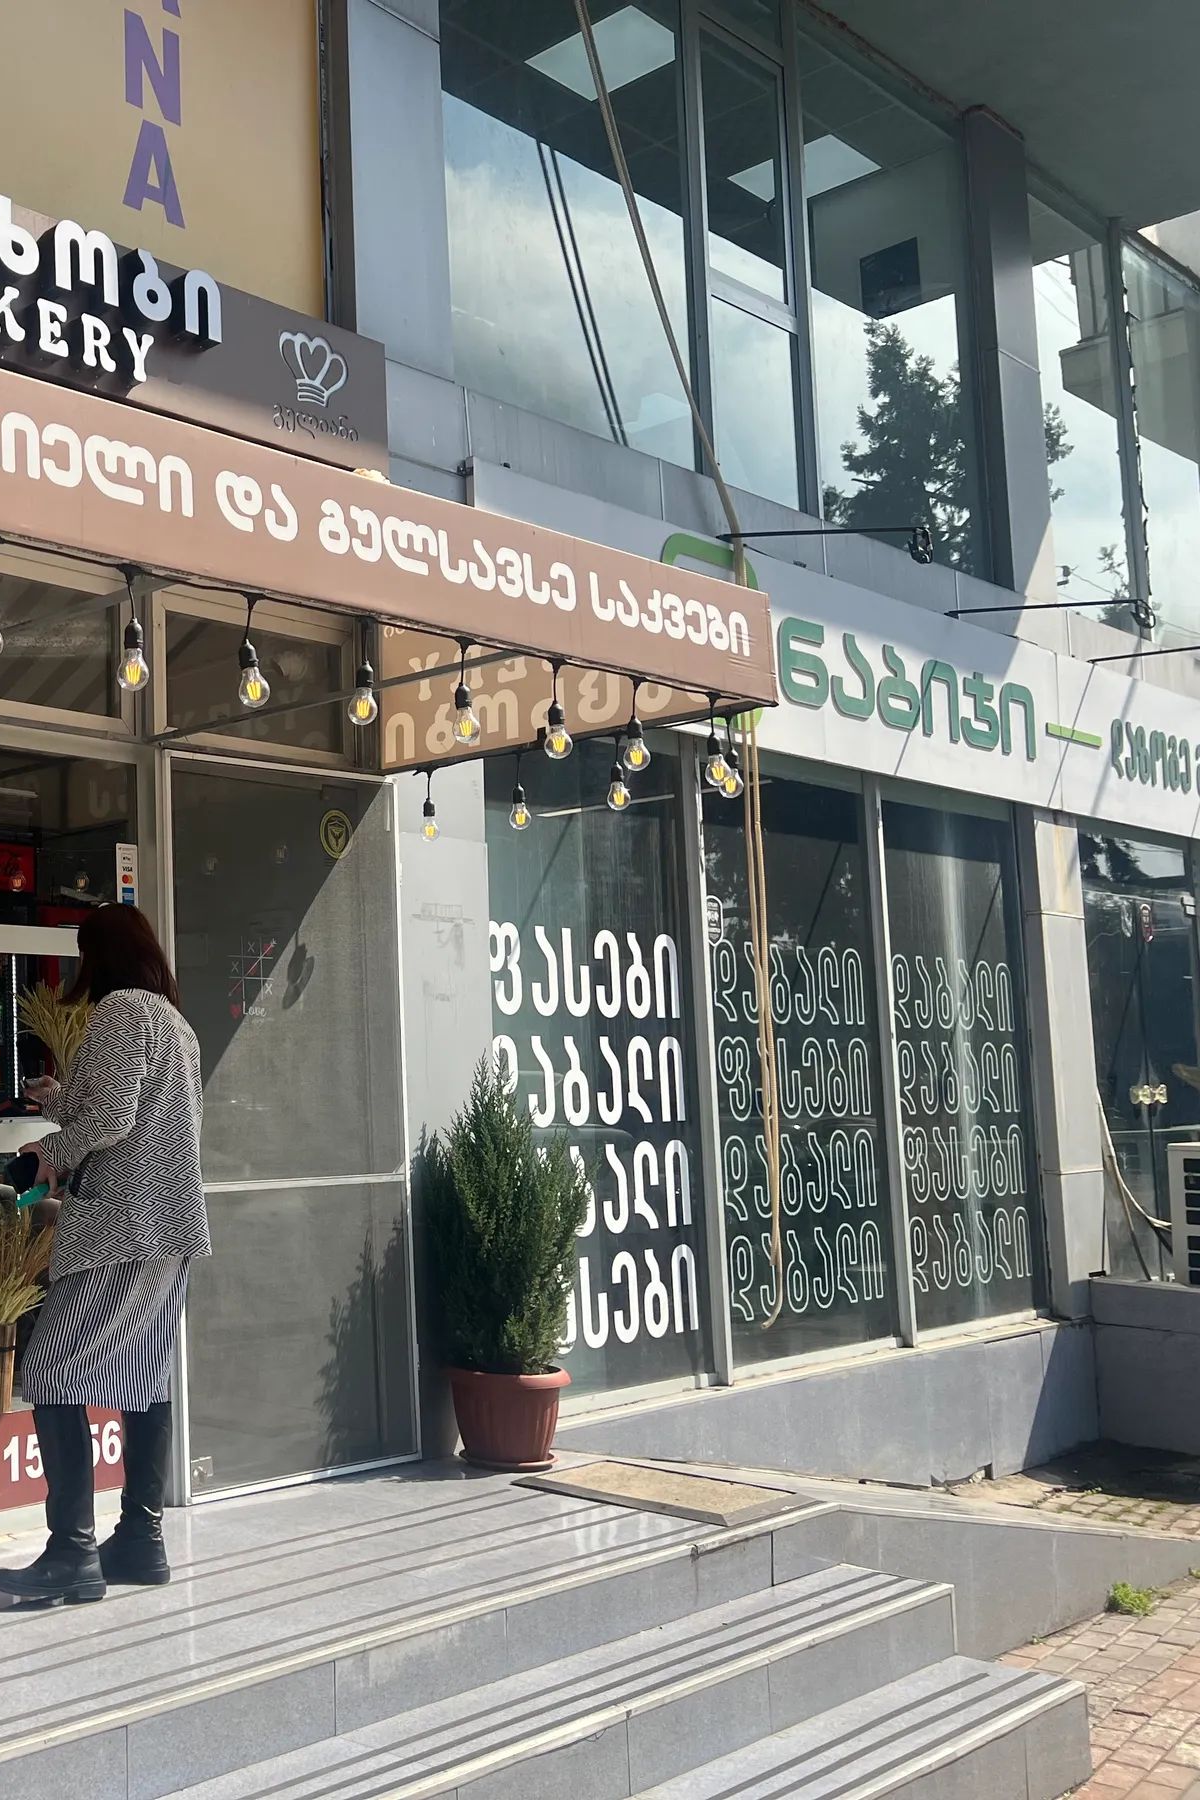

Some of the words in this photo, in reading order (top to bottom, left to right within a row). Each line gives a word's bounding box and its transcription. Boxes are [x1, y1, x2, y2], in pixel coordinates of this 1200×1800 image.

[272, 402, 360, 442] გულიანი
[215, 470, 299, 542] და
[318, 498, 577, 612] გულსავსე
[589, 571, 752, 657] საკვები
[778, 615, 1037, 762] ნაბიჯი
[489, 920, 680, 1019] ფასები
[714, 940, 866, 1025] დაბალი
[891, 954, 1015, 1032] დაბალი
[897, 1040, 1021, 1115] დაბალი
[723, 1129, 878, 1222] დაბალი
[903, 1123, 1027, 1203] ფასები
[909, 1206, 1033, 1293] დაბალი
